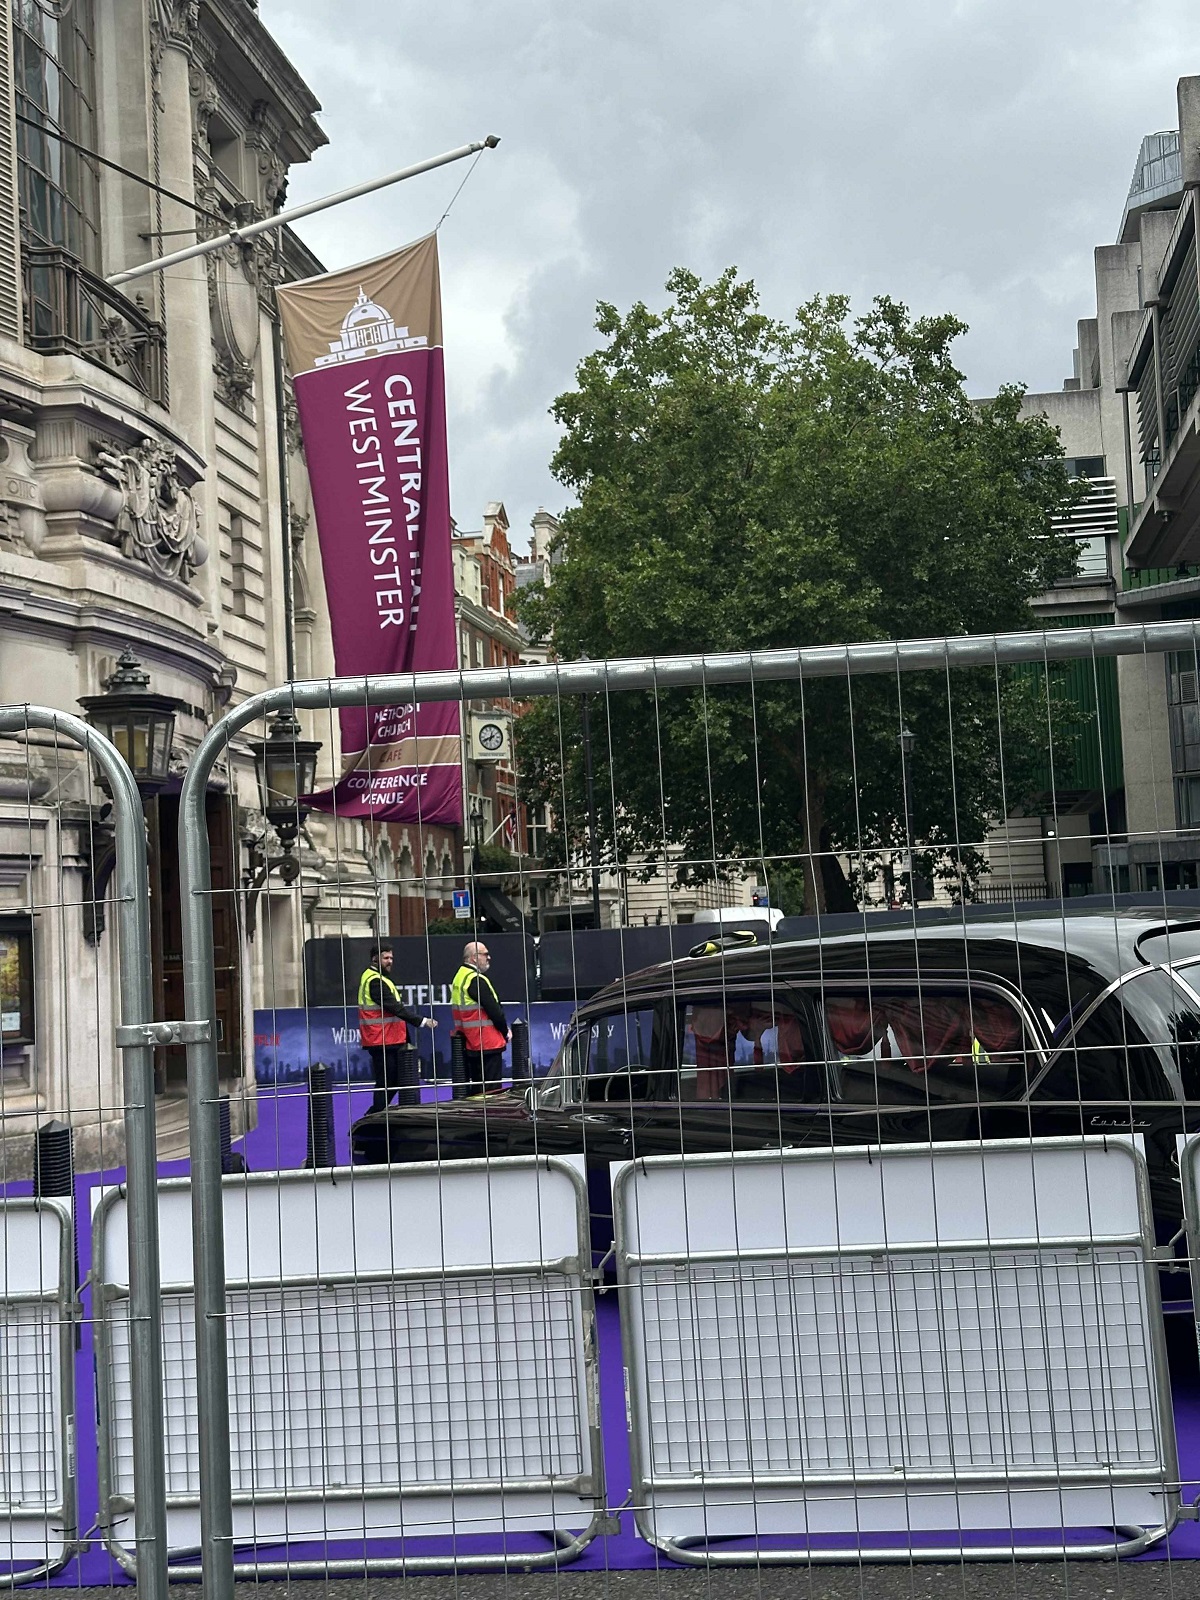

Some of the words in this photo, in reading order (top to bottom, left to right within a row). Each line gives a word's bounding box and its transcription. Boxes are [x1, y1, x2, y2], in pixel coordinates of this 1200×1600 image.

[384, 374, 423, 541] CENTRAL
[343, 379, 405, 630] WESTMINSTER
[347, 773, 428, 789] CONFERENCE
[361, 791, 404, 805] VENUE
[394, 984, 453, 1006] ETFLI
